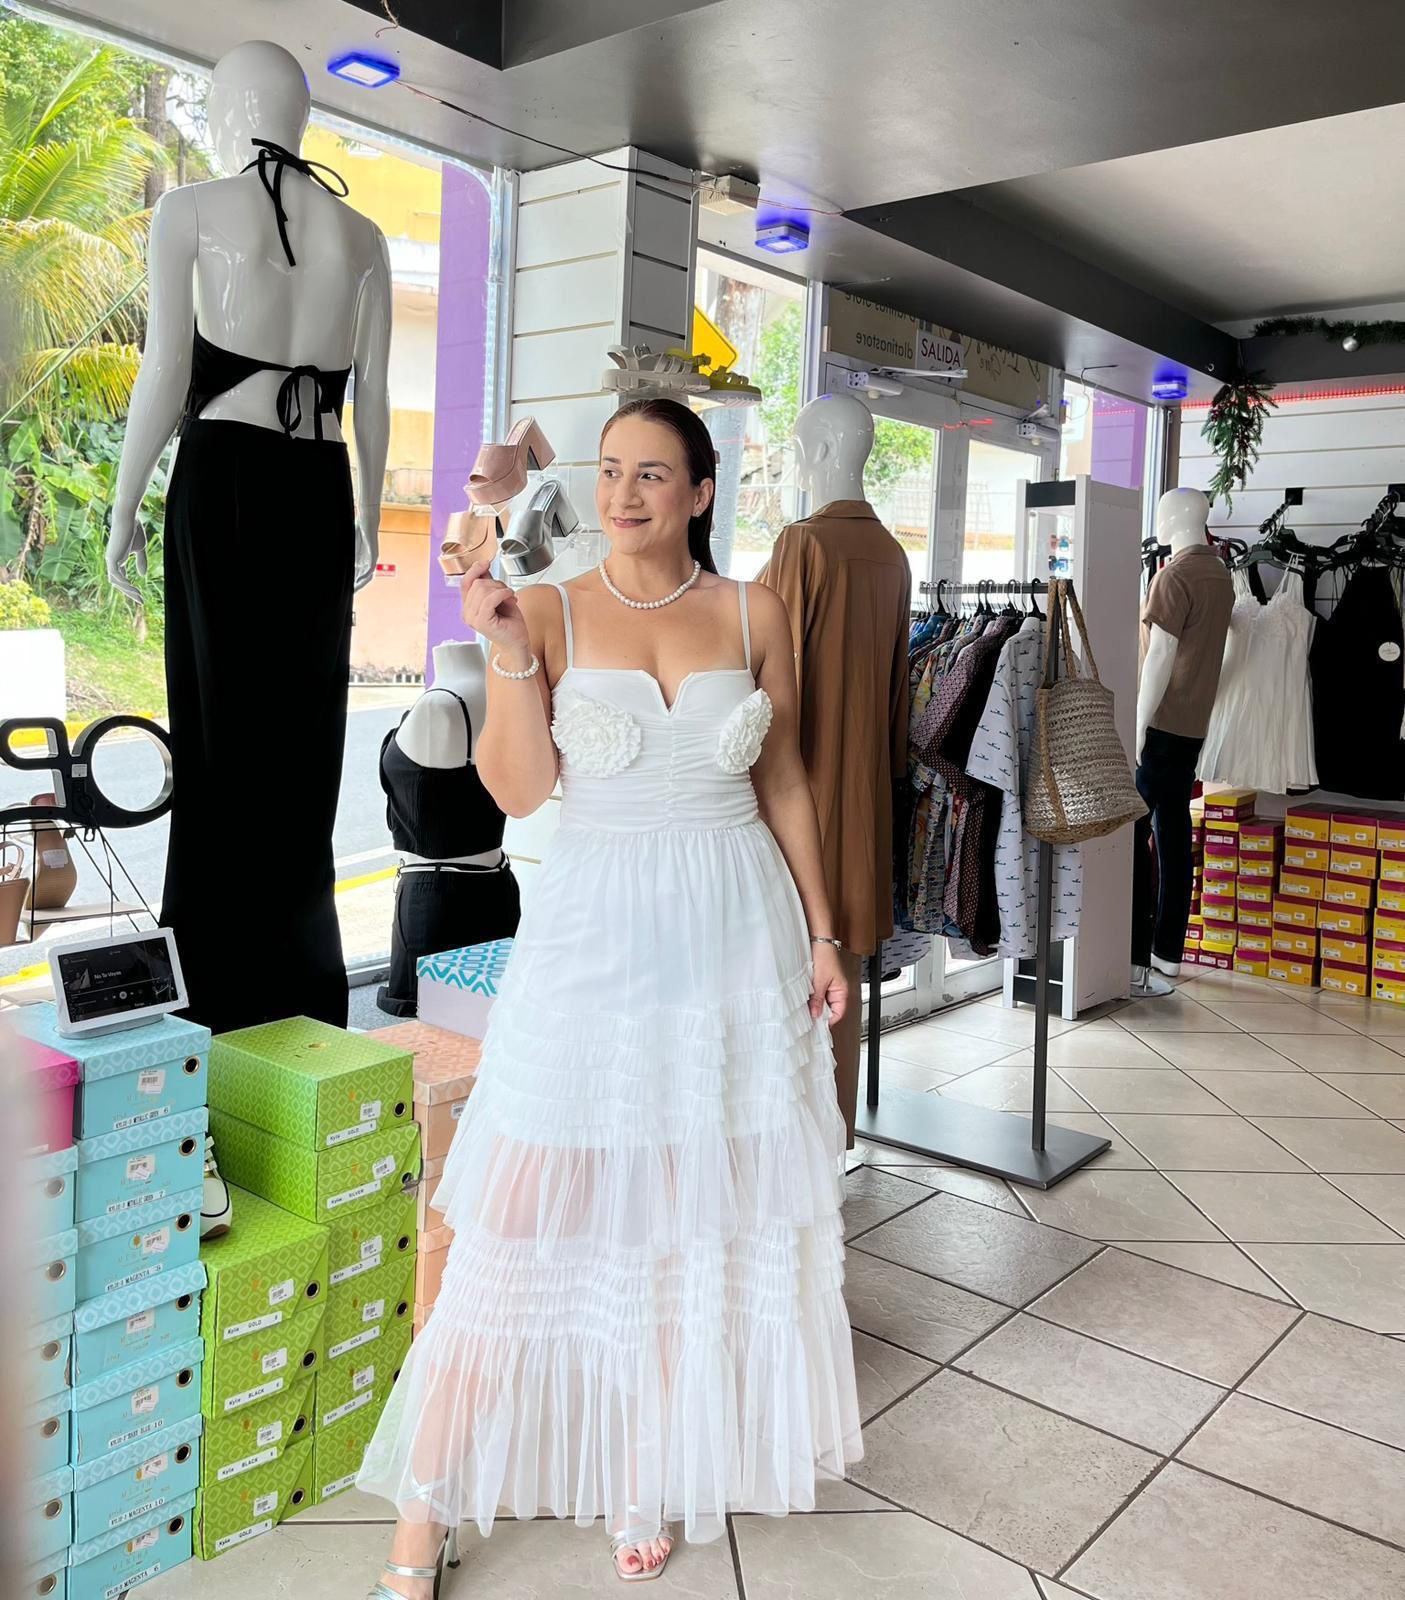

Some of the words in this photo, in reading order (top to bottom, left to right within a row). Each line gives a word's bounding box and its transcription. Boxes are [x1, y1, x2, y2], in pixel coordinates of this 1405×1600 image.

[920, 338, 961, 367] SALIDA
[248, 1388, 265, 1399] BLACK
[242, 1457, 259, 1468] BLACK
